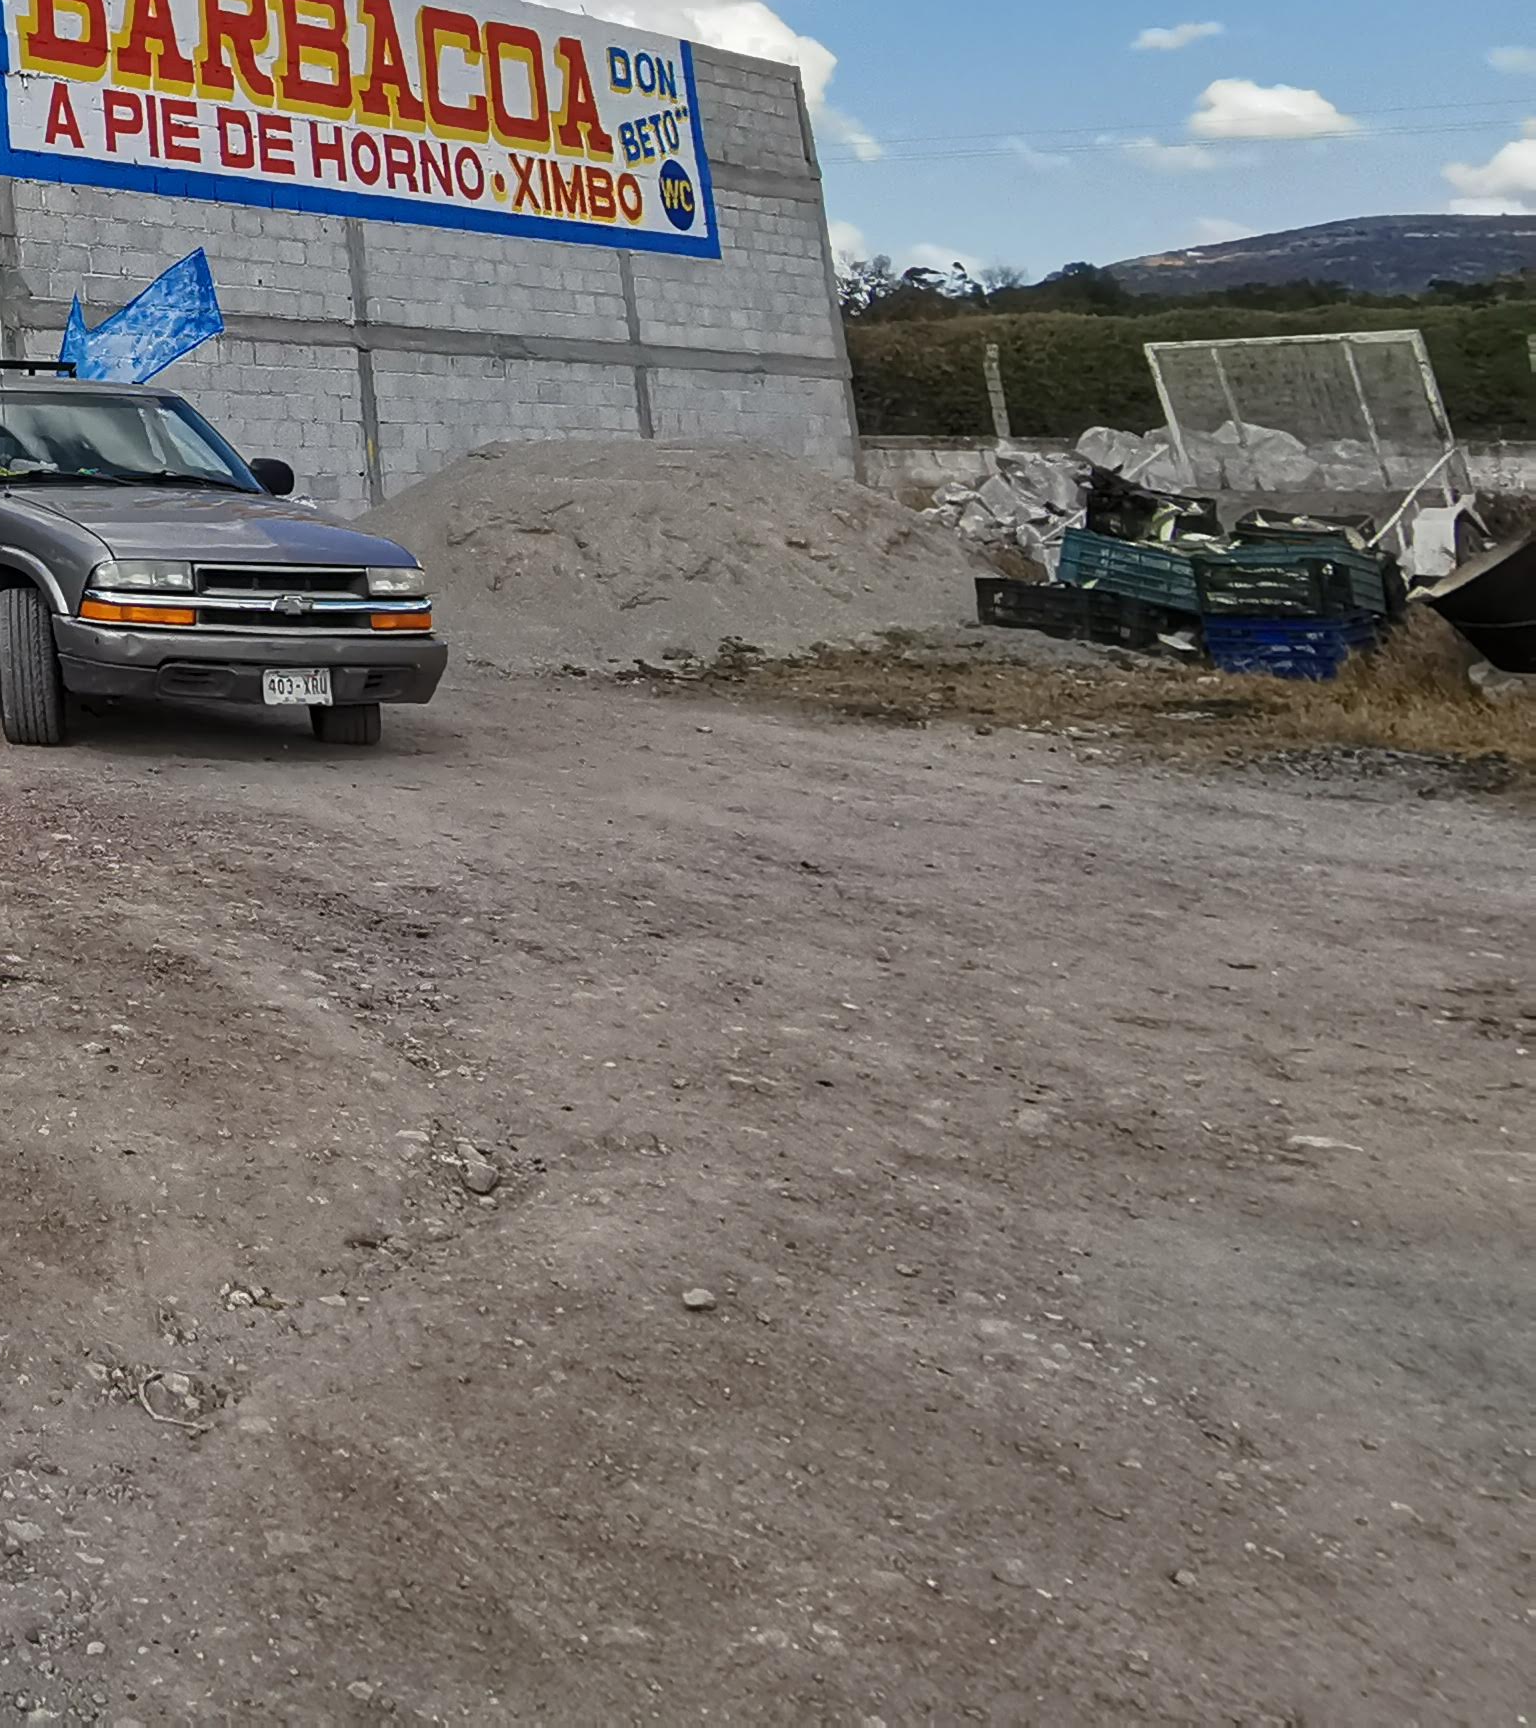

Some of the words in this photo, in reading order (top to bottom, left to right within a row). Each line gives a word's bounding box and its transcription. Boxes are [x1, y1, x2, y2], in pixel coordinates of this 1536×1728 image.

[607, 47, 679, 103] DON
[45, 82, 85, 149] A
[103, 89, 202, 164] PIE
[217, 107, 296, 175] DE
[309, 121, 484, 201] HORNO
[508, 152, 643, 225] XIMBO
[660, 176, 695, 213] WC
